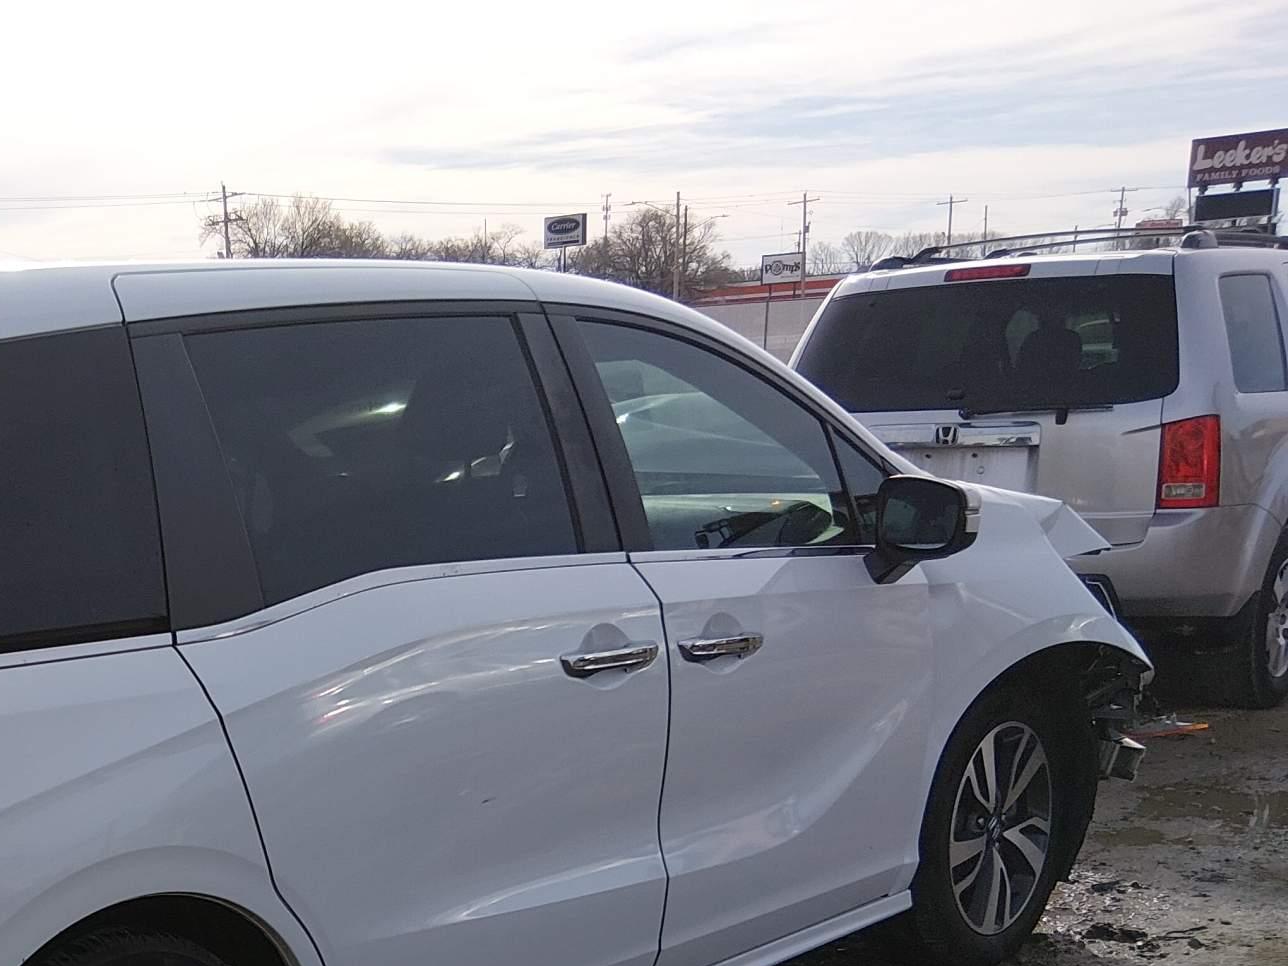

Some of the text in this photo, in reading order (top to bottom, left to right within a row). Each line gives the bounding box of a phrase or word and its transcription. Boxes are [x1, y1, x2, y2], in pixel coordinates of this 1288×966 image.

[1193, 140, 1288, 170] Leeker's
[1196, 166, 1281, 181] FAMILY FOODS
